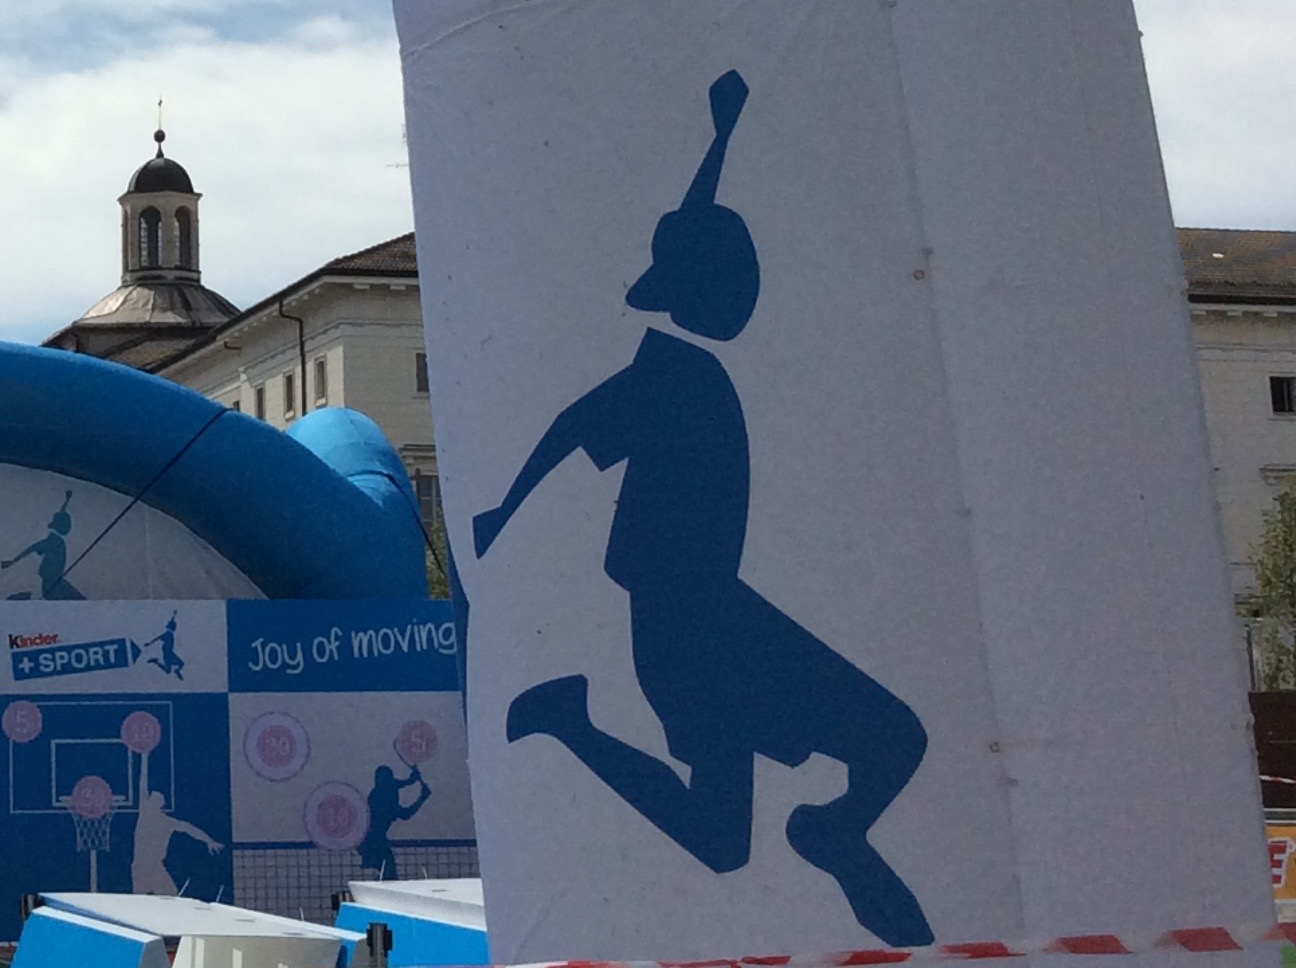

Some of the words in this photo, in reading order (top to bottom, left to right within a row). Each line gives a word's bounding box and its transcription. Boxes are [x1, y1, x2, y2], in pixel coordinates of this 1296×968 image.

[248, 637, 304, 674] Joy
[312, 626, 342, 663] of
[352, 618, 458, 658] moving
[410, 730, 426, 753] 5
